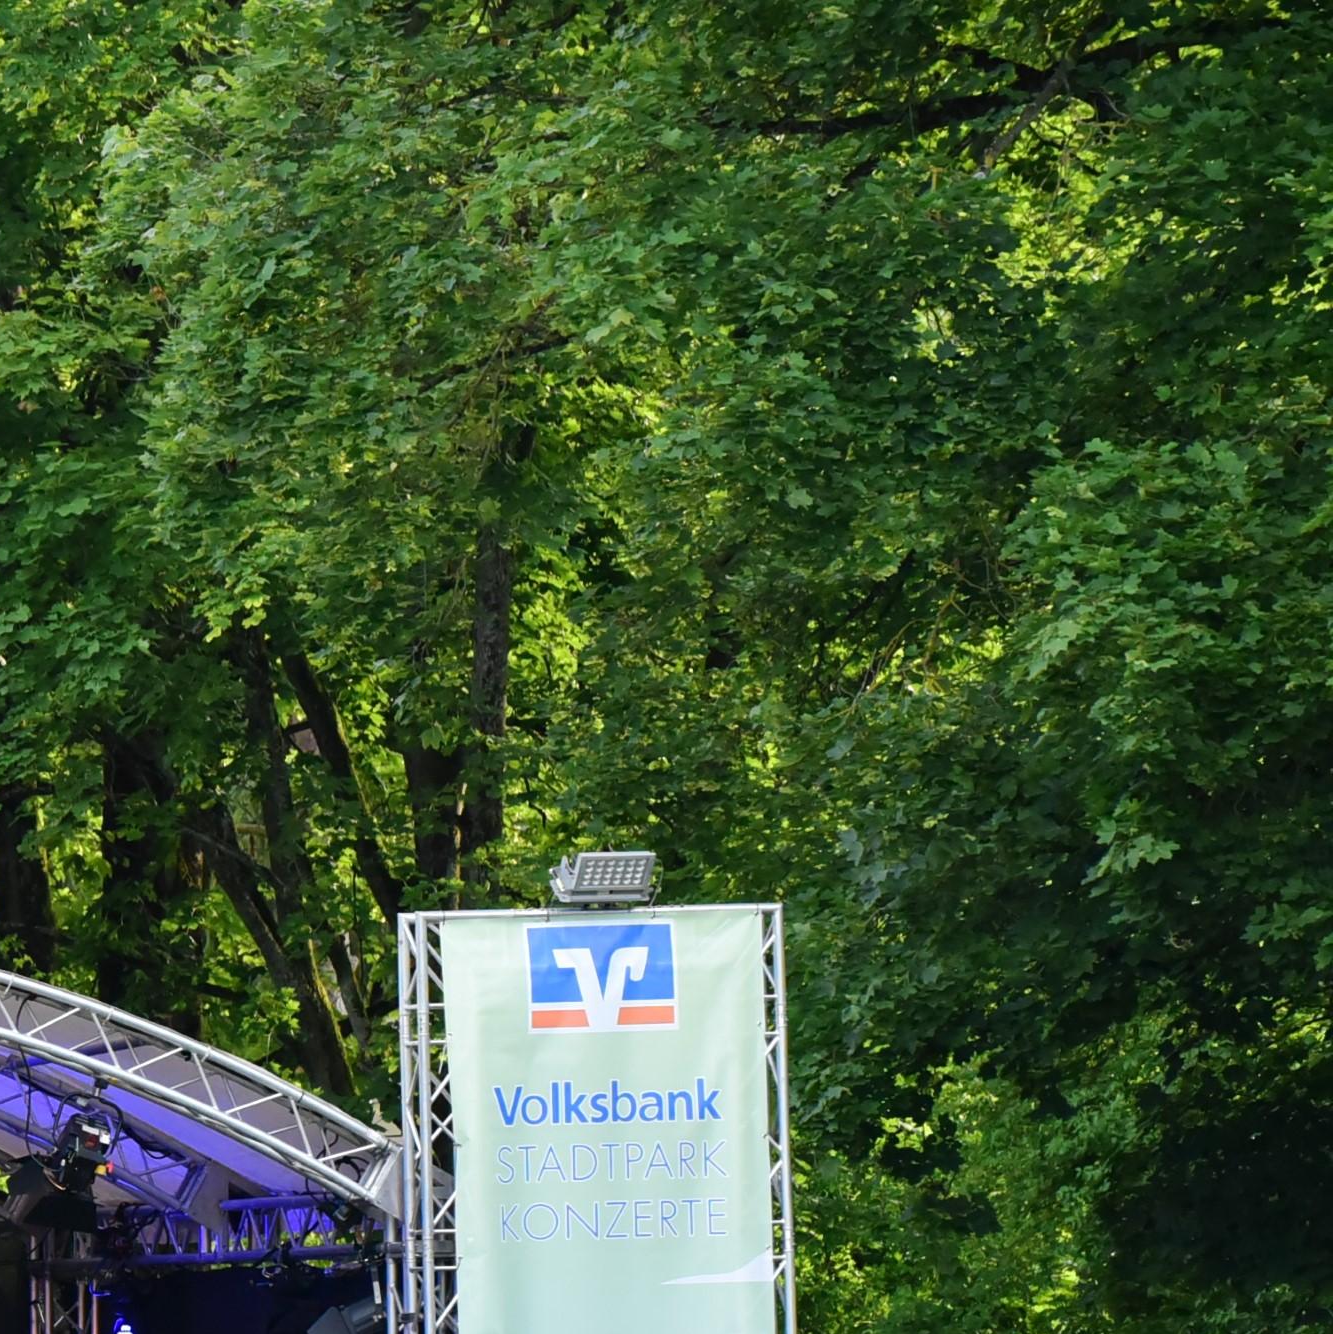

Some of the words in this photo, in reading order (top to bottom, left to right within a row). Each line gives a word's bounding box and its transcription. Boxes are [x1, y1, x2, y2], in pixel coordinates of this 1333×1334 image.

[493, 1077, 722, 1127] Volksbank
[496, 1140, 728, 1184] STADTPARK
[501, 1198, 727, 1242] KONZERTE
